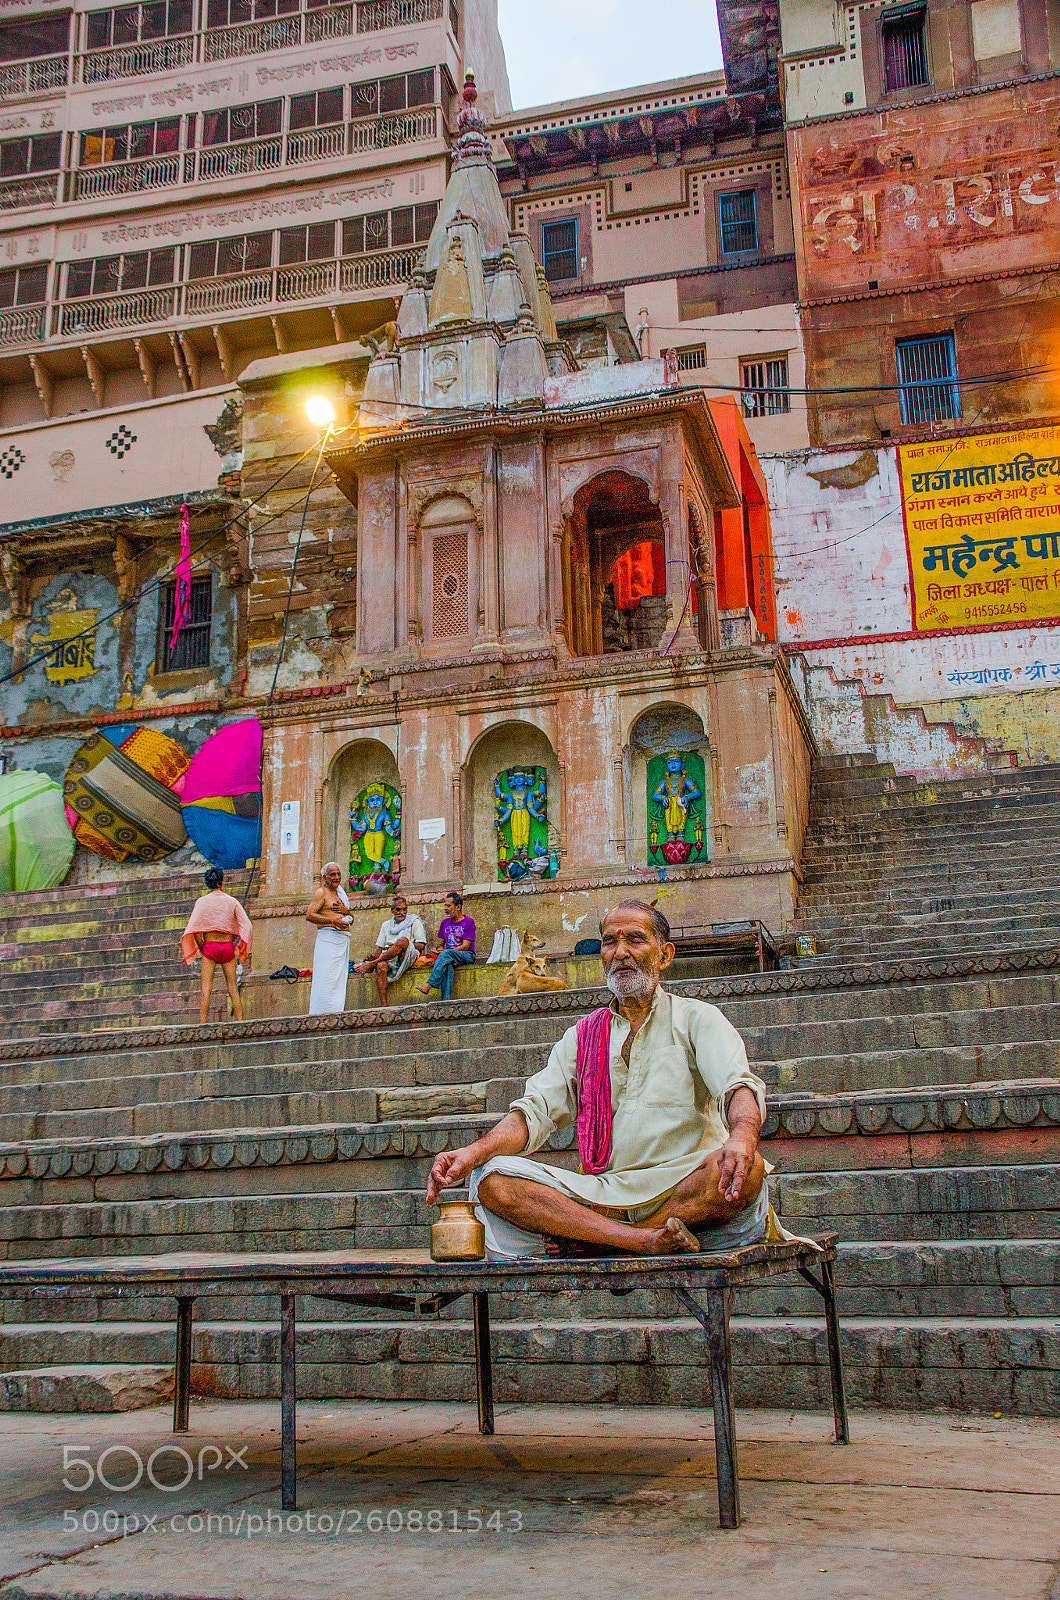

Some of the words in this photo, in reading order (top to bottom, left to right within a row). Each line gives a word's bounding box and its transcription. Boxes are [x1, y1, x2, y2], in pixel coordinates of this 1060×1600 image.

[913, 519, 938, 531] पाल
[941, 513, 983, 529] विकास
[922, 534, 1021, 578] महेन्द्र
[926, 583, 961, 601] जिला
[964, 602, 1028, 619] 9415552458
